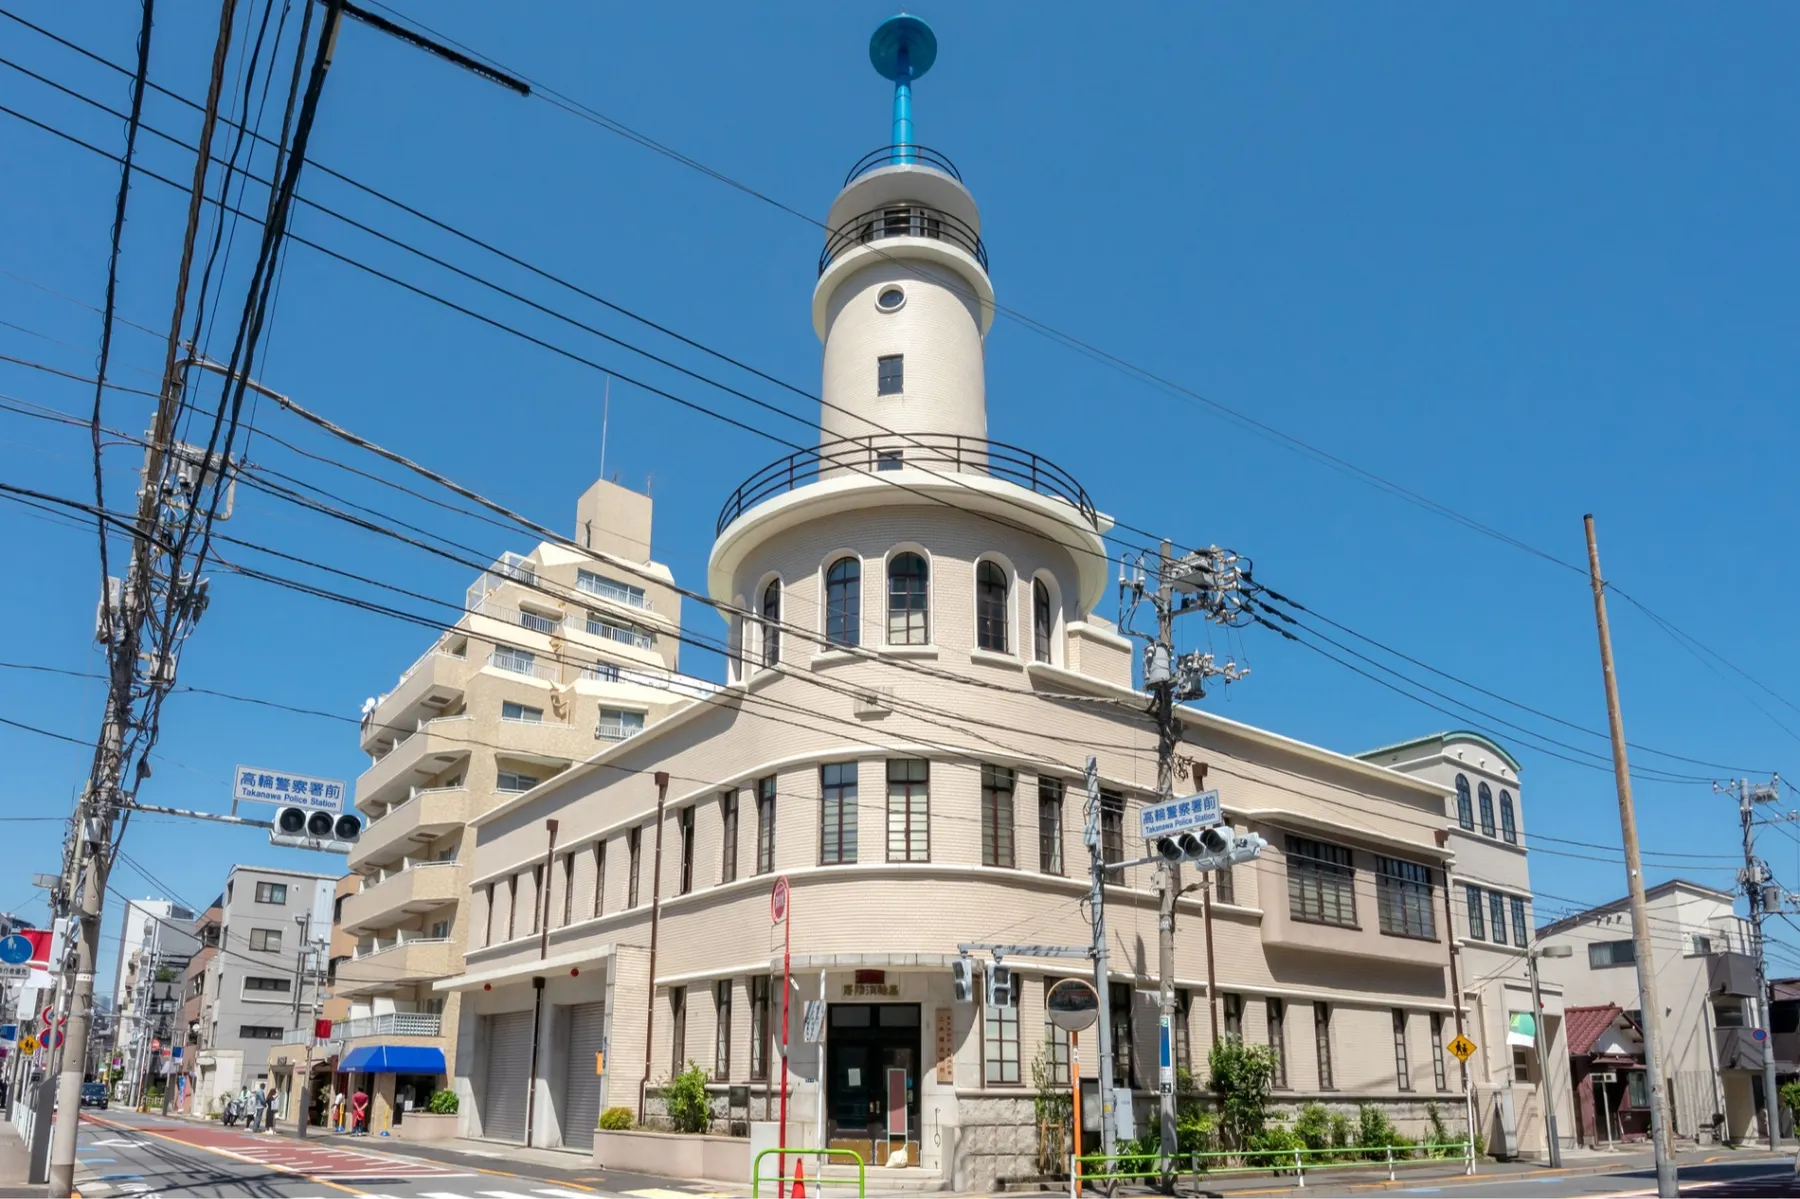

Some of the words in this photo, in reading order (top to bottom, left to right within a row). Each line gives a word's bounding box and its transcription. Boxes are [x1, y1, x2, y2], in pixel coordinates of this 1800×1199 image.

[240, 772, 341, 800] 高輪警察署前
[241, 787, 282, 801] Takanawa
[284, 793, 308, 805] Police
[310, 797, 337, 808] Station
[1143, 795, 1216, 825] 高輪警察署前
[1145, 822, 1174, 834] Takanawa
[1175, 817, 1193, 827] Police
[1194, 812, 1216, 822] Station
[0, 967, 27, 976] 行者優先
